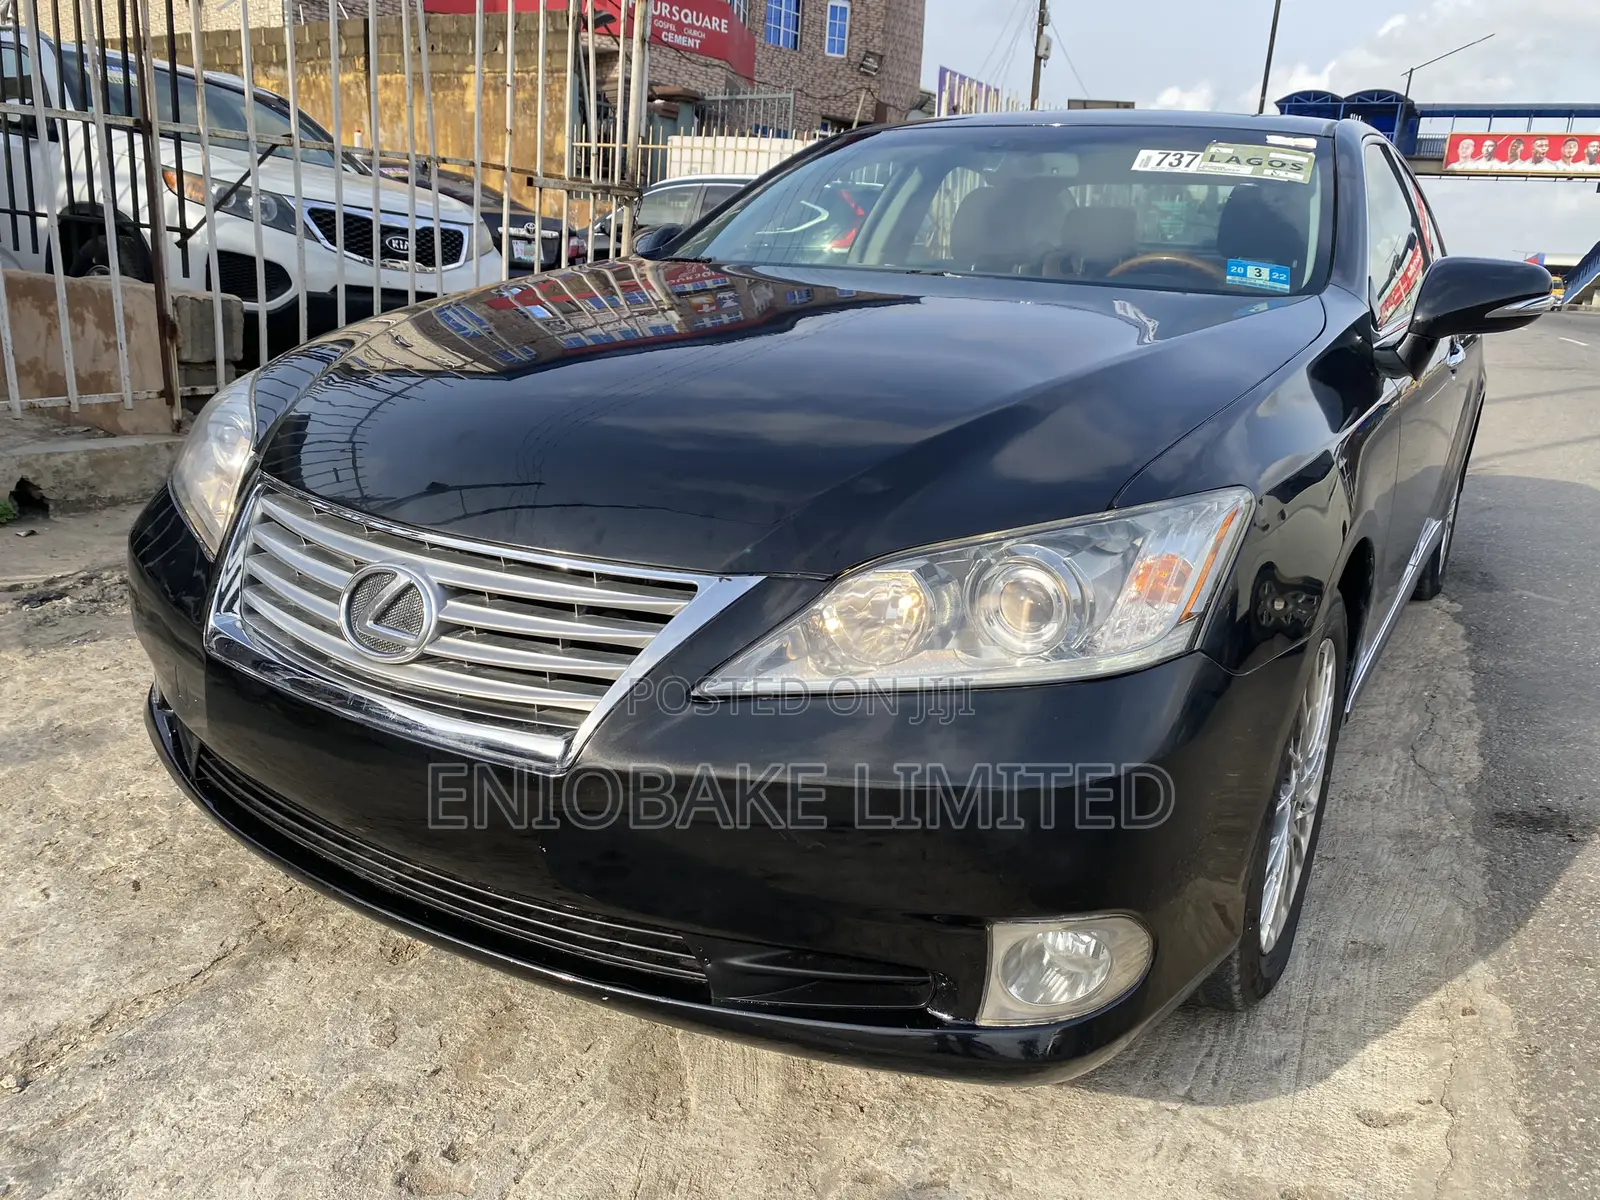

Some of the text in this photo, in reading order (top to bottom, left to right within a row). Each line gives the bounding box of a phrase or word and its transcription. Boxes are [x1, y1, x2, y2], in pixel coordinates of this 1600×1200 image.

[629, 0, 729, 34] URSQUARE
[653, 19, 706, 39] GOSPEL CHURCH
[661, 31, 701, 49] CEMENT
[1155, 151, 1200, 168] 737
[1208, 154, 1304, 171] LAGOS
[1230, 265, 1287, 281] 20 3 22
